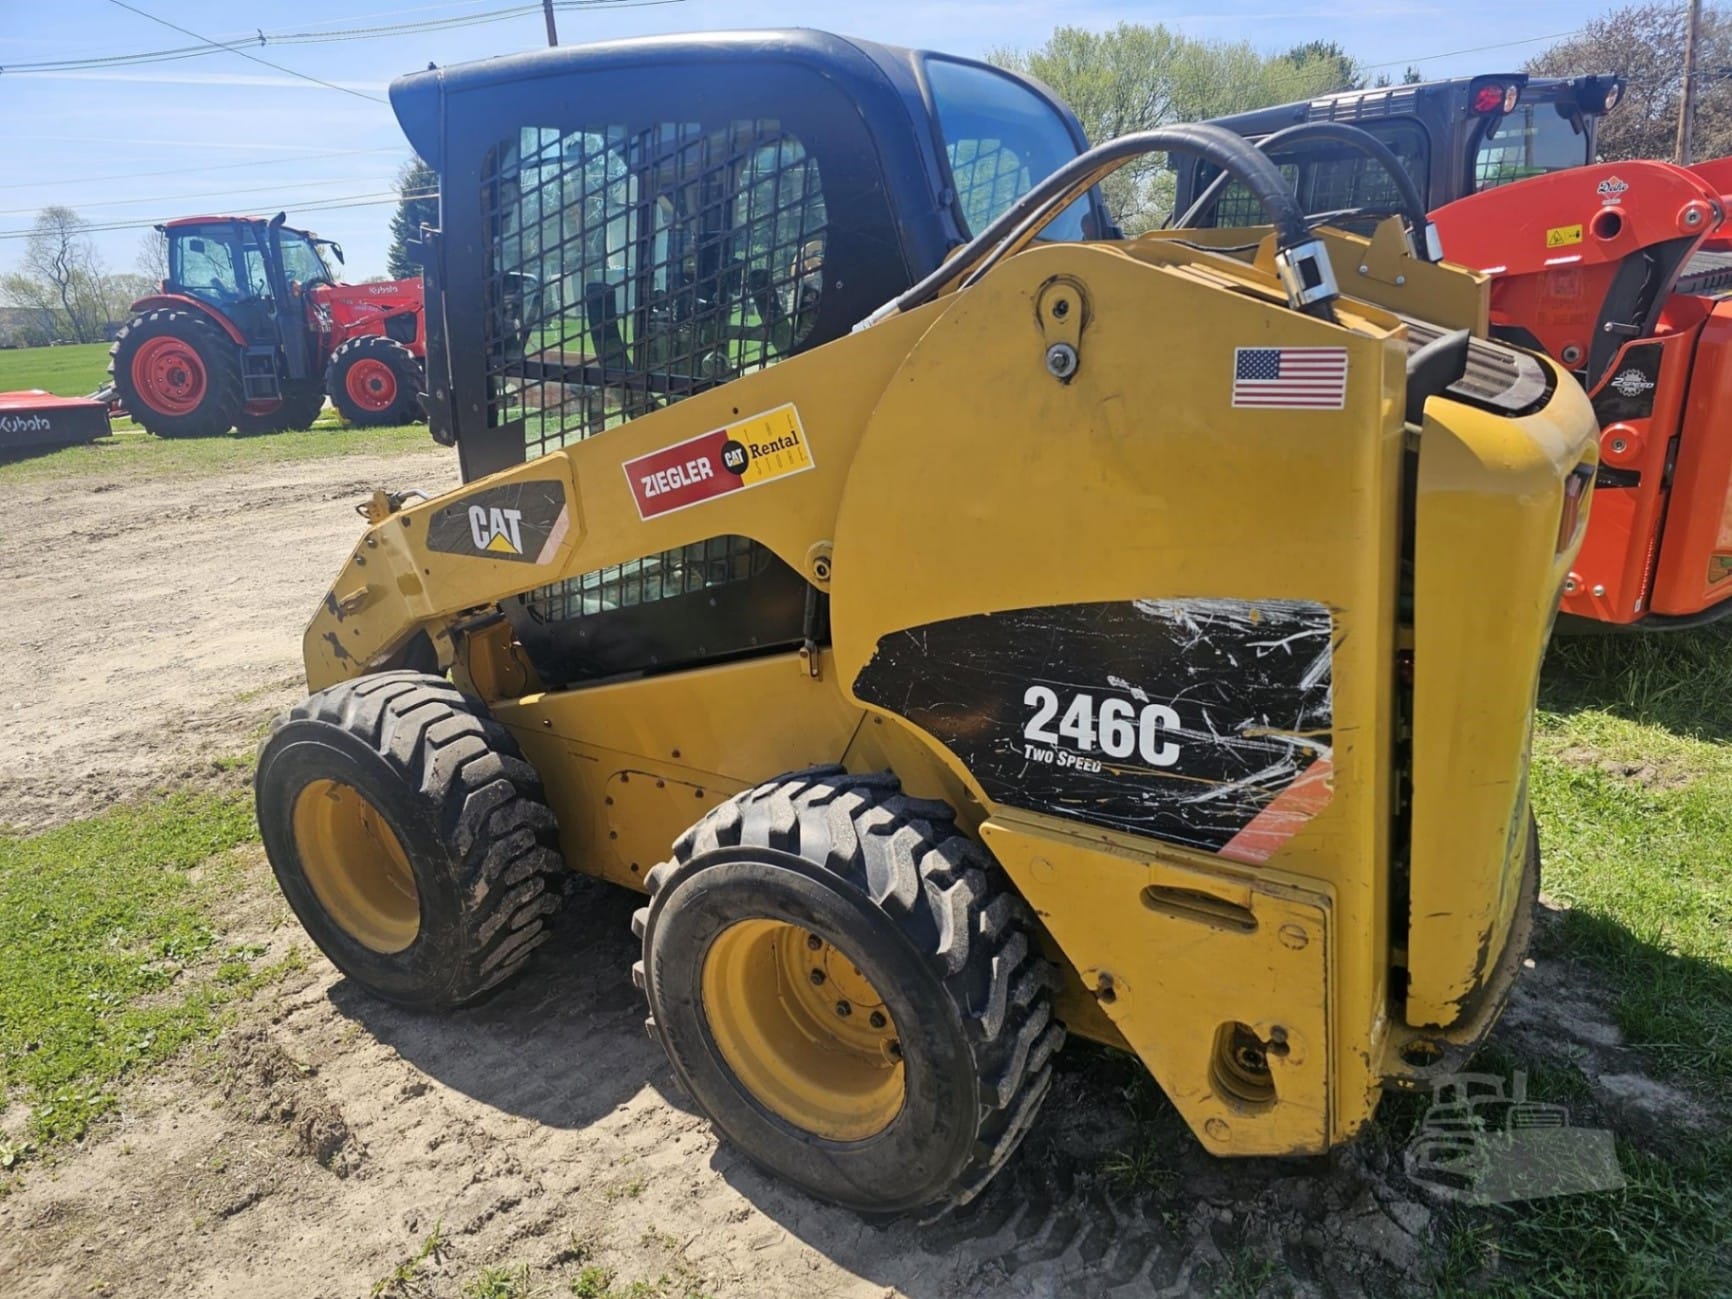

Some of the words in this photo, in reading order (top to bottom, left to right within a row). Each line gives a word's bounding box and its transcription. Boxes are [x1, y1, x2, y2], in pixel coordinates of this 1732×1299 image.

[0, 414, 51, 432] Kubota
[640, 456, 714, 498] ZIEGLER
[724, 448, 744, 468] CAT
[748, 430, 800, 460] Rental
[468, 505, 524, 554] CAT
[1024, 685, 1181, 767] 246C
